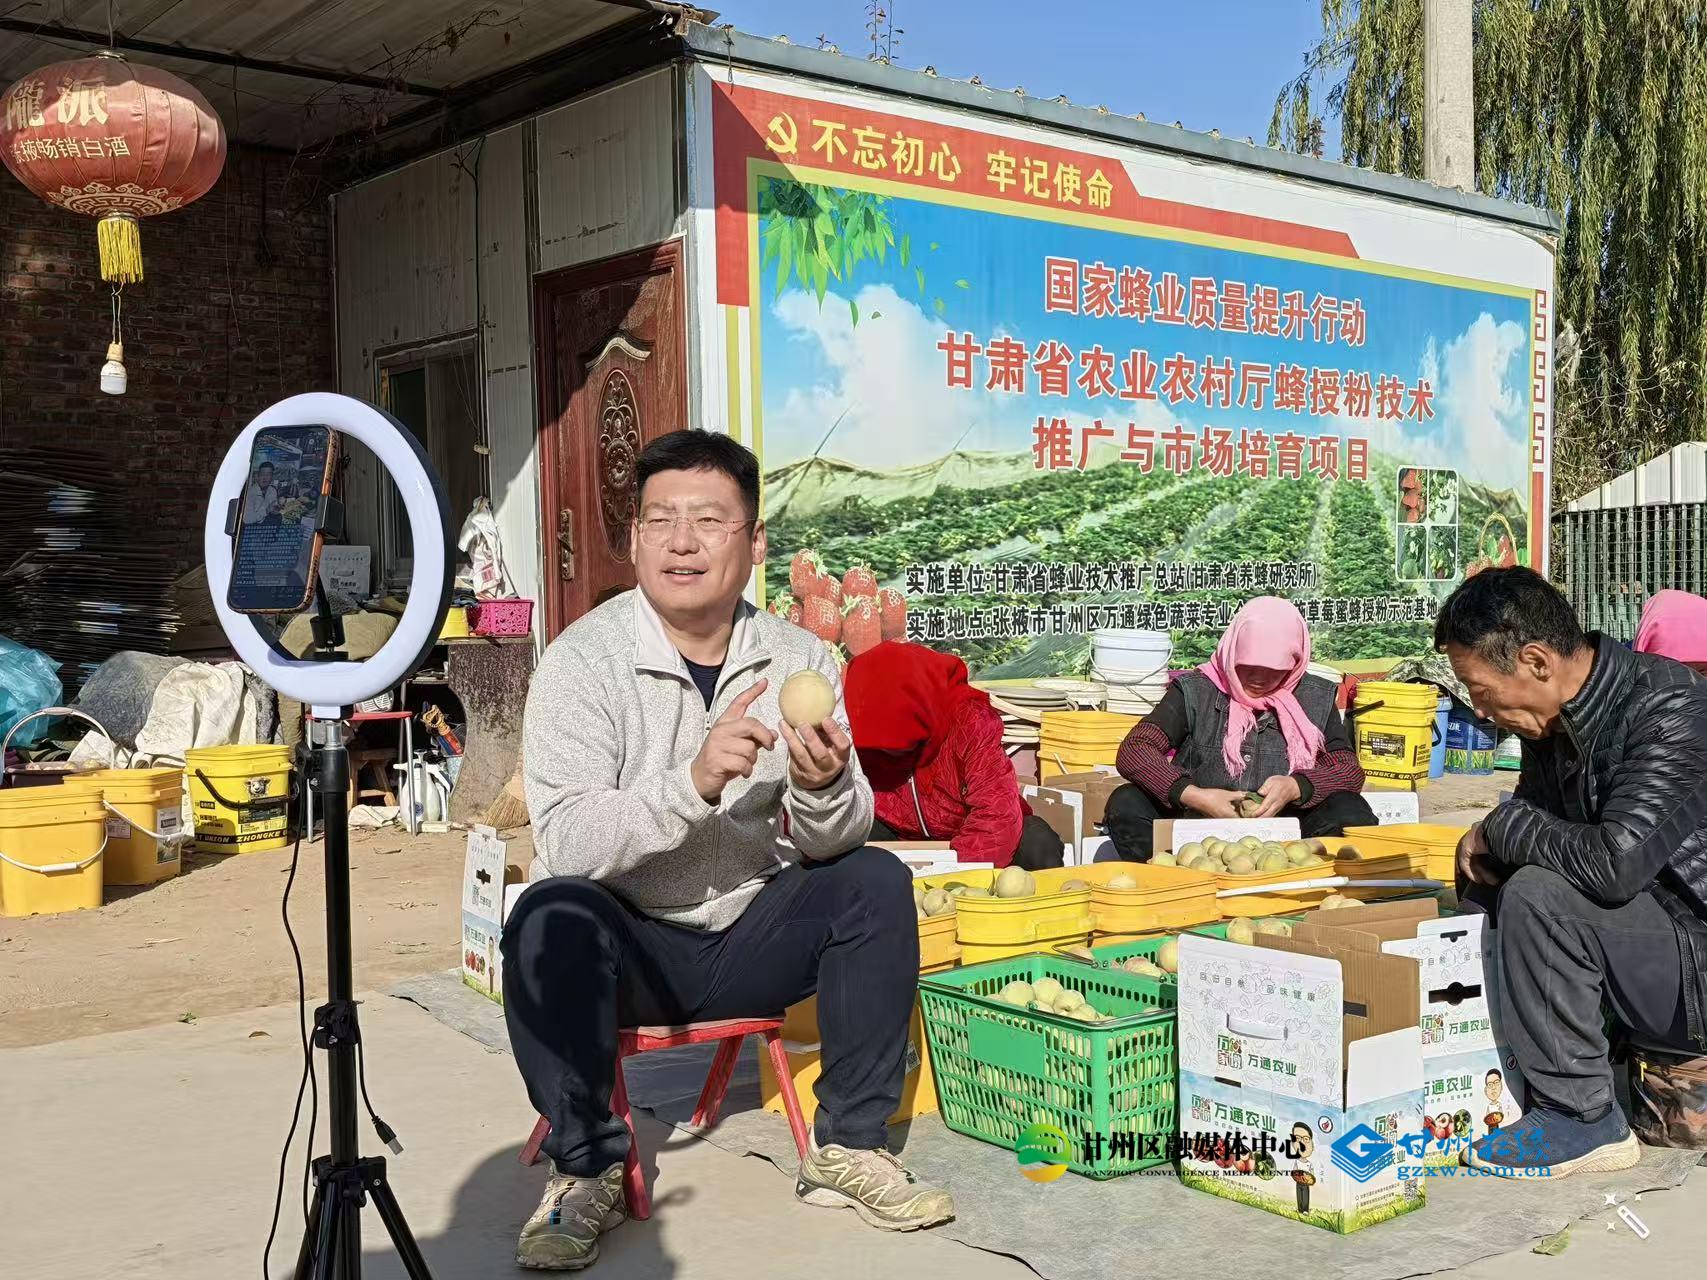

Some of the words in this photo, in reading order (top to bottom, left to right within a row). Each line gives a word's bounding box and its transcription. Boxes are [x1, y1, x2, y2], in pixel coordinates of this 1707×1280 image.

[811, 119, 960, 182] 不忘初心
[987, 150, 1113, 209] 牢记使命
[1044, 256, 1366, 347] 国家蜂业质量提升行动
[937, 332, 1435, 423] 甘肃省农业农村厅蜂授粉技术
[1032, 416, 1368, 482] 推广与市场培育项目
[236, 831, 281, 843] ZHONGKE
[1448, 1018, 1490, 1035] 万通农业
[1247, 1053, 1297, 1077] 万通农业
[1214, 1102, 1277, 1133] 万通农业
